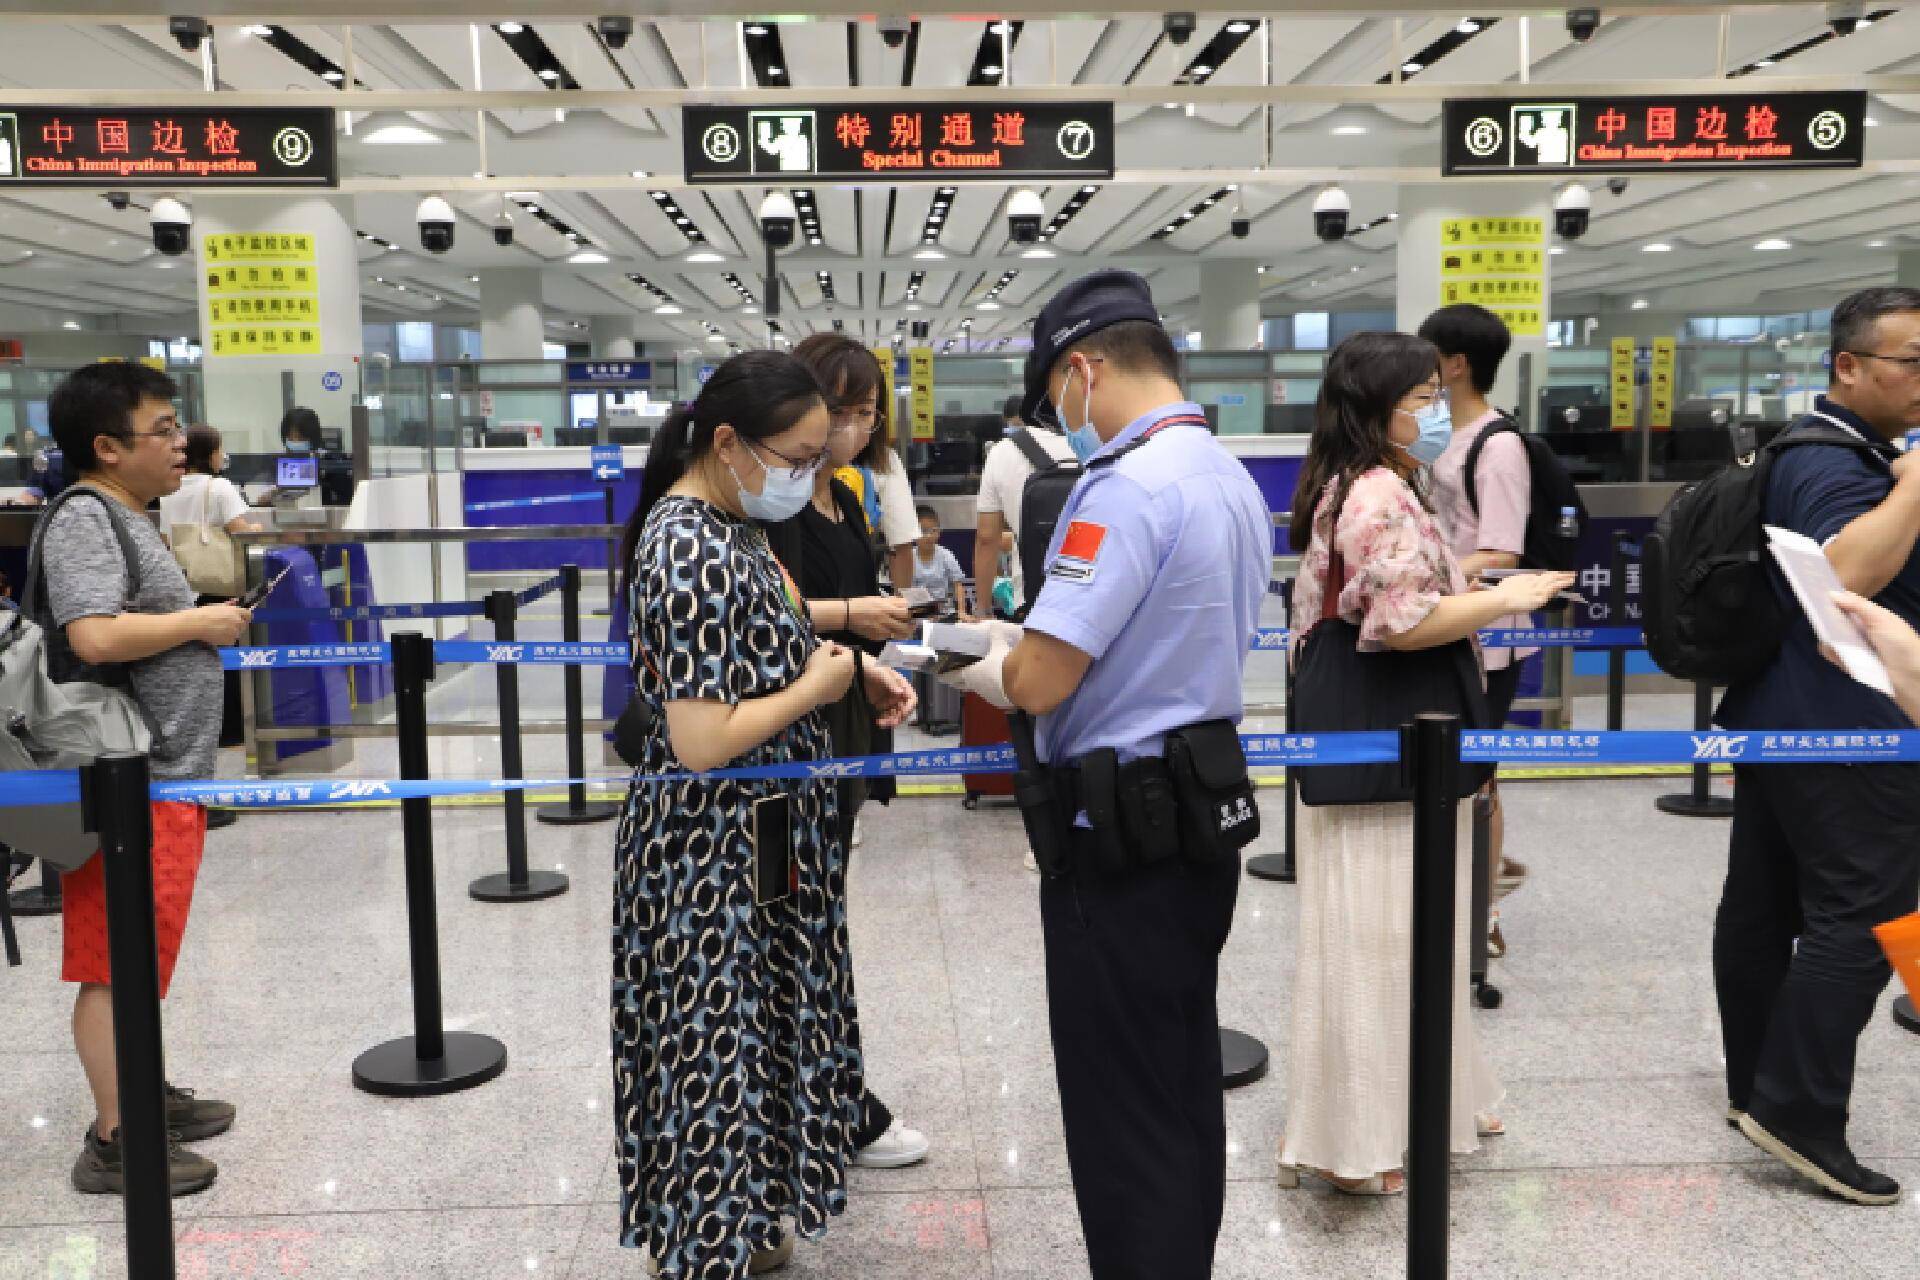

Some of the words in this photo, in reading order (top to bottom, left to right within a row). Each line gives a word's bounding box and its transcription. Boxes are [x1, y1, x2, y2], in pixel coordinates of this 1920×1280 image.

[43, 117, 240, 154] 中国边检
[835, 111, 1026, 149] 特别通道
[1595, 105, 1778, 142] 中国边检
[27, 156, 74, 172] China
[75, 156, 174, 176] Immigration
[176, 156, 257, 176] Inspection
[863, 150, 924, 170] Special
[930, 149, 1003, 167] Channel
[1579, 144, 1623, 160] China
[1626, 143, 1714, 161] Immigration
[1717, 142, 1792, 160] Inspection
